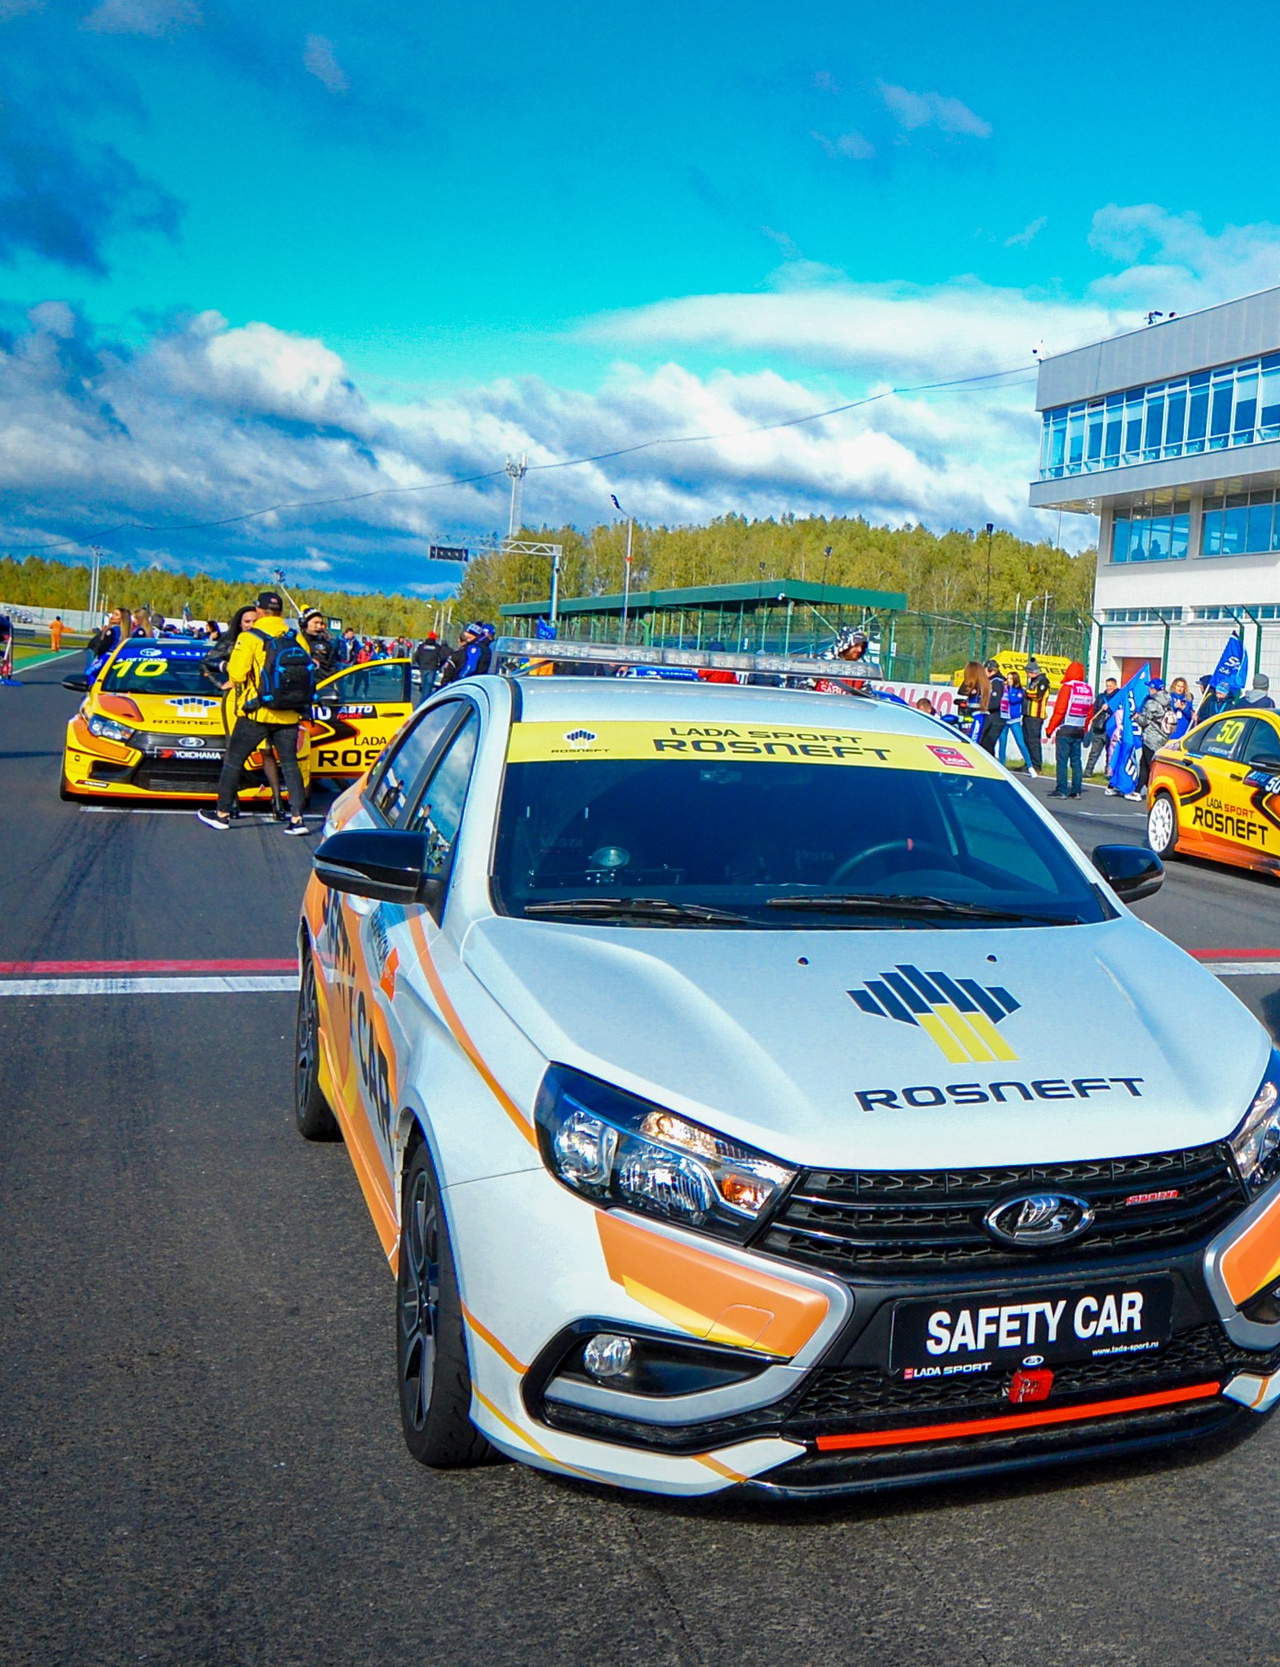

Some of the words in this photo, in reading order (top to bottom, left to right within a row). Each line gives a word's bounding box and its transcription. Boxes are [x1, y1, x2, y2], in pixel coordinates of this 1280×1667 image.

[112, 661, 168, 678] 10
[354, 736, 387, 746] LADA
[669, 727, 740, 738] LADA
[747, 730, 863, 744] SPORT
[1216, 720, 1245, 745] 50
[174, 751, 222, 760] YOKOHAMA
[652, 738, 891, 761] ROSNEFT
[1206, 797, 1223, 810] LADA
[1224, 804, 1255, 819] SPORT
[1192, 806, 1269, 845] ROSNEFT
[358, 991, 395, 1163] CAR
[854, 1077, 1145, 1112] ROSNEFT
[1125, 1190, 1179, 1206] SPORT
[926, 1300, 1067, 1356] SAFETY
[1074, 1291, 1144, 1339] CAR
[1091, 1341, 1159, 1357] www.lada-sport.ru
[913, 1367, 941, 1379] LADA
[943, 1362, 992, 1376] SPORT
